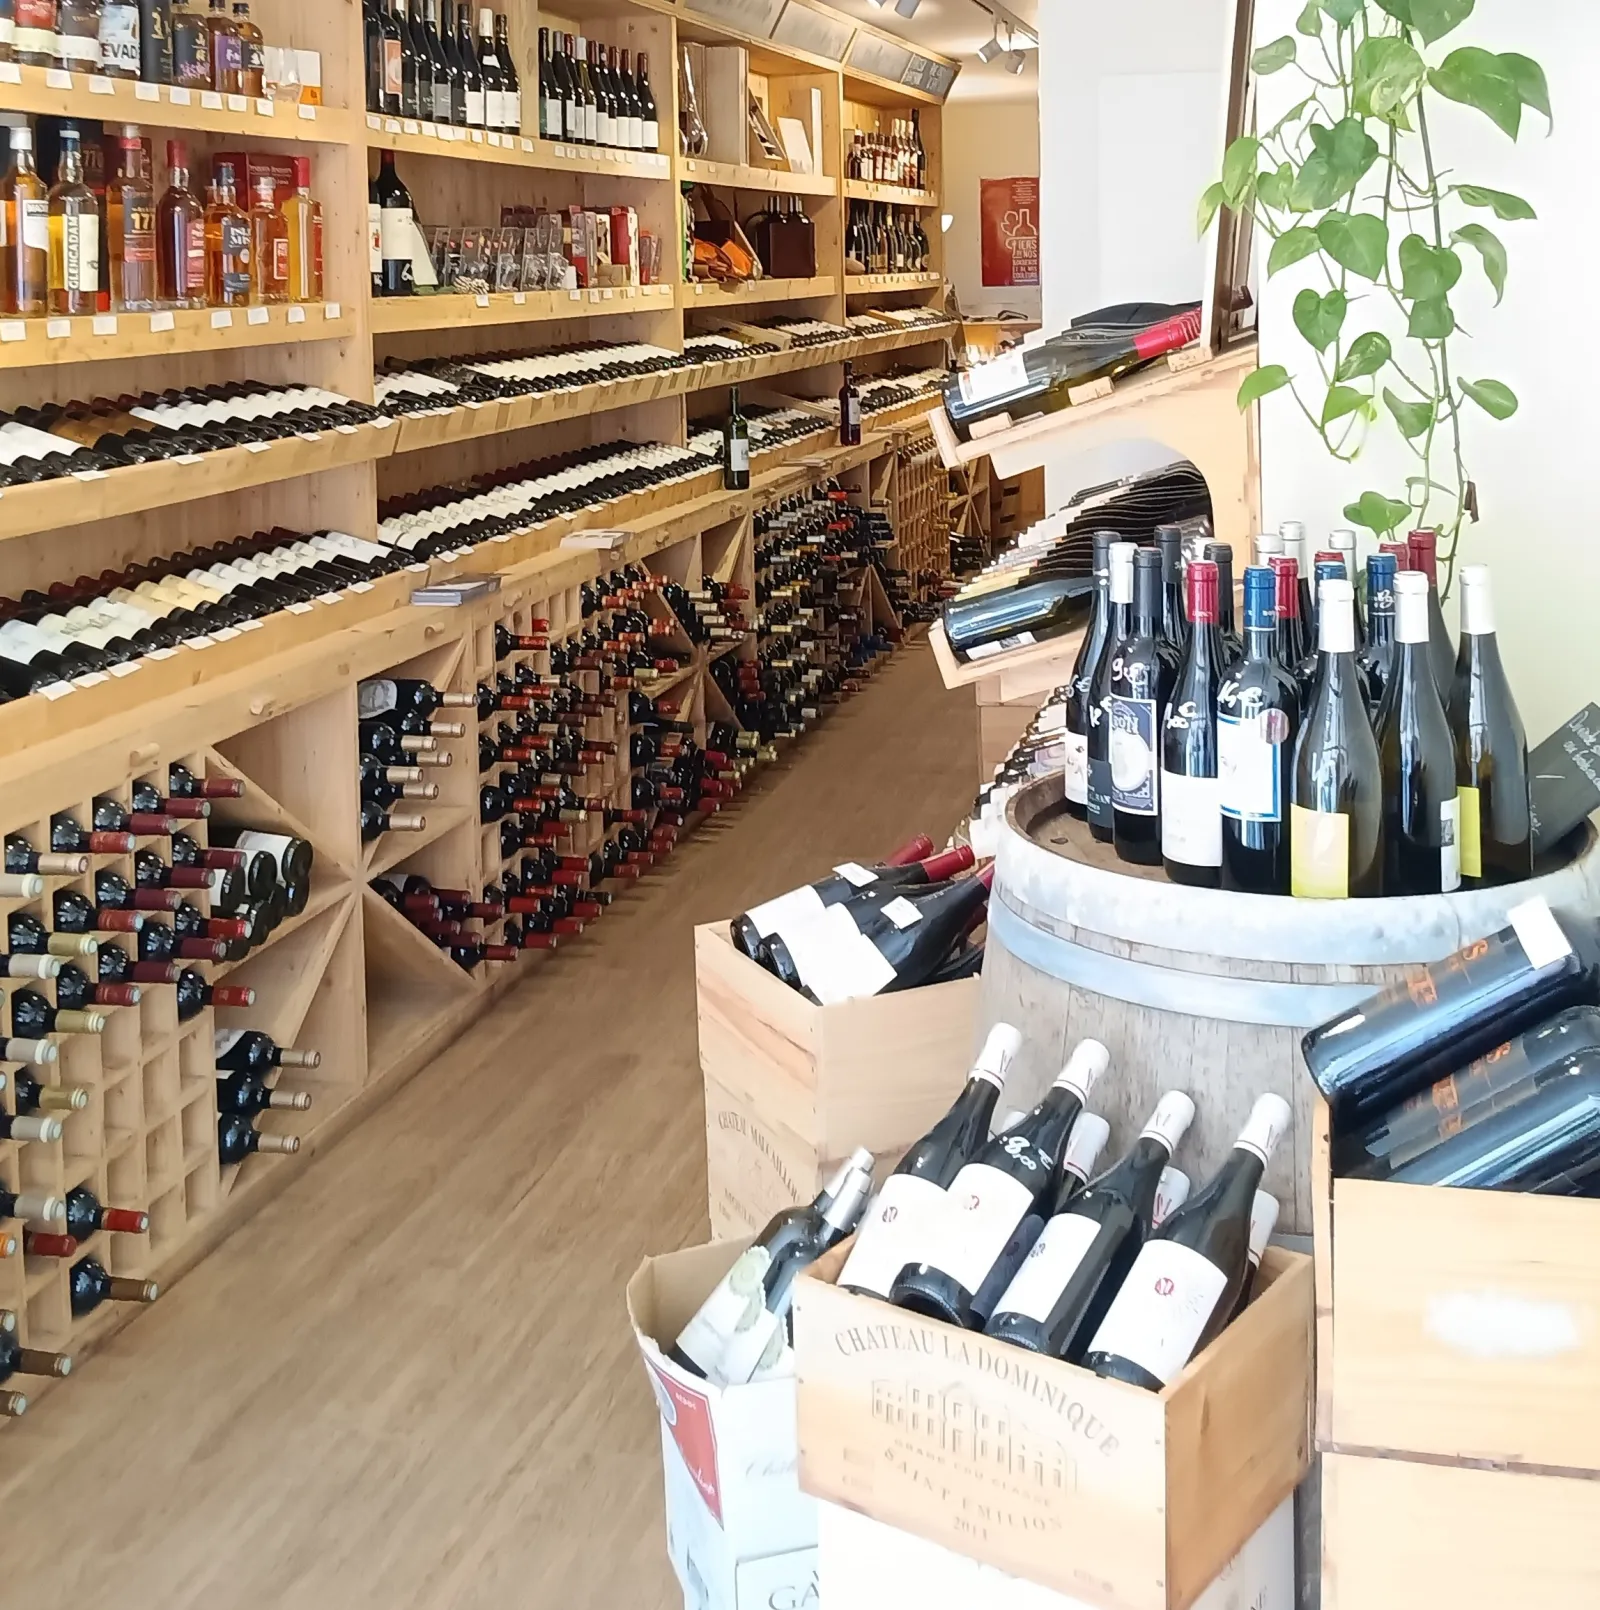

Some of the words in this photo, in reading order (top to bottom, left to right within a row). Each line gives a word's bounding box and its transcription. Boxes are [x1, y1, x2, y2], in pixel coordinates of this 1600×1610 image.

[68, 215, 79, 289] GLENCADAM
[835, 1326, 934, 1356] CHATEAU
[943, 1335, 969, 1365] LA
[978, 1346, 1120, 1457] DOMINIQUE
[884, 1448, 950, 1501] SAINT
[962, 1497, 1063, 1530] EMILION
